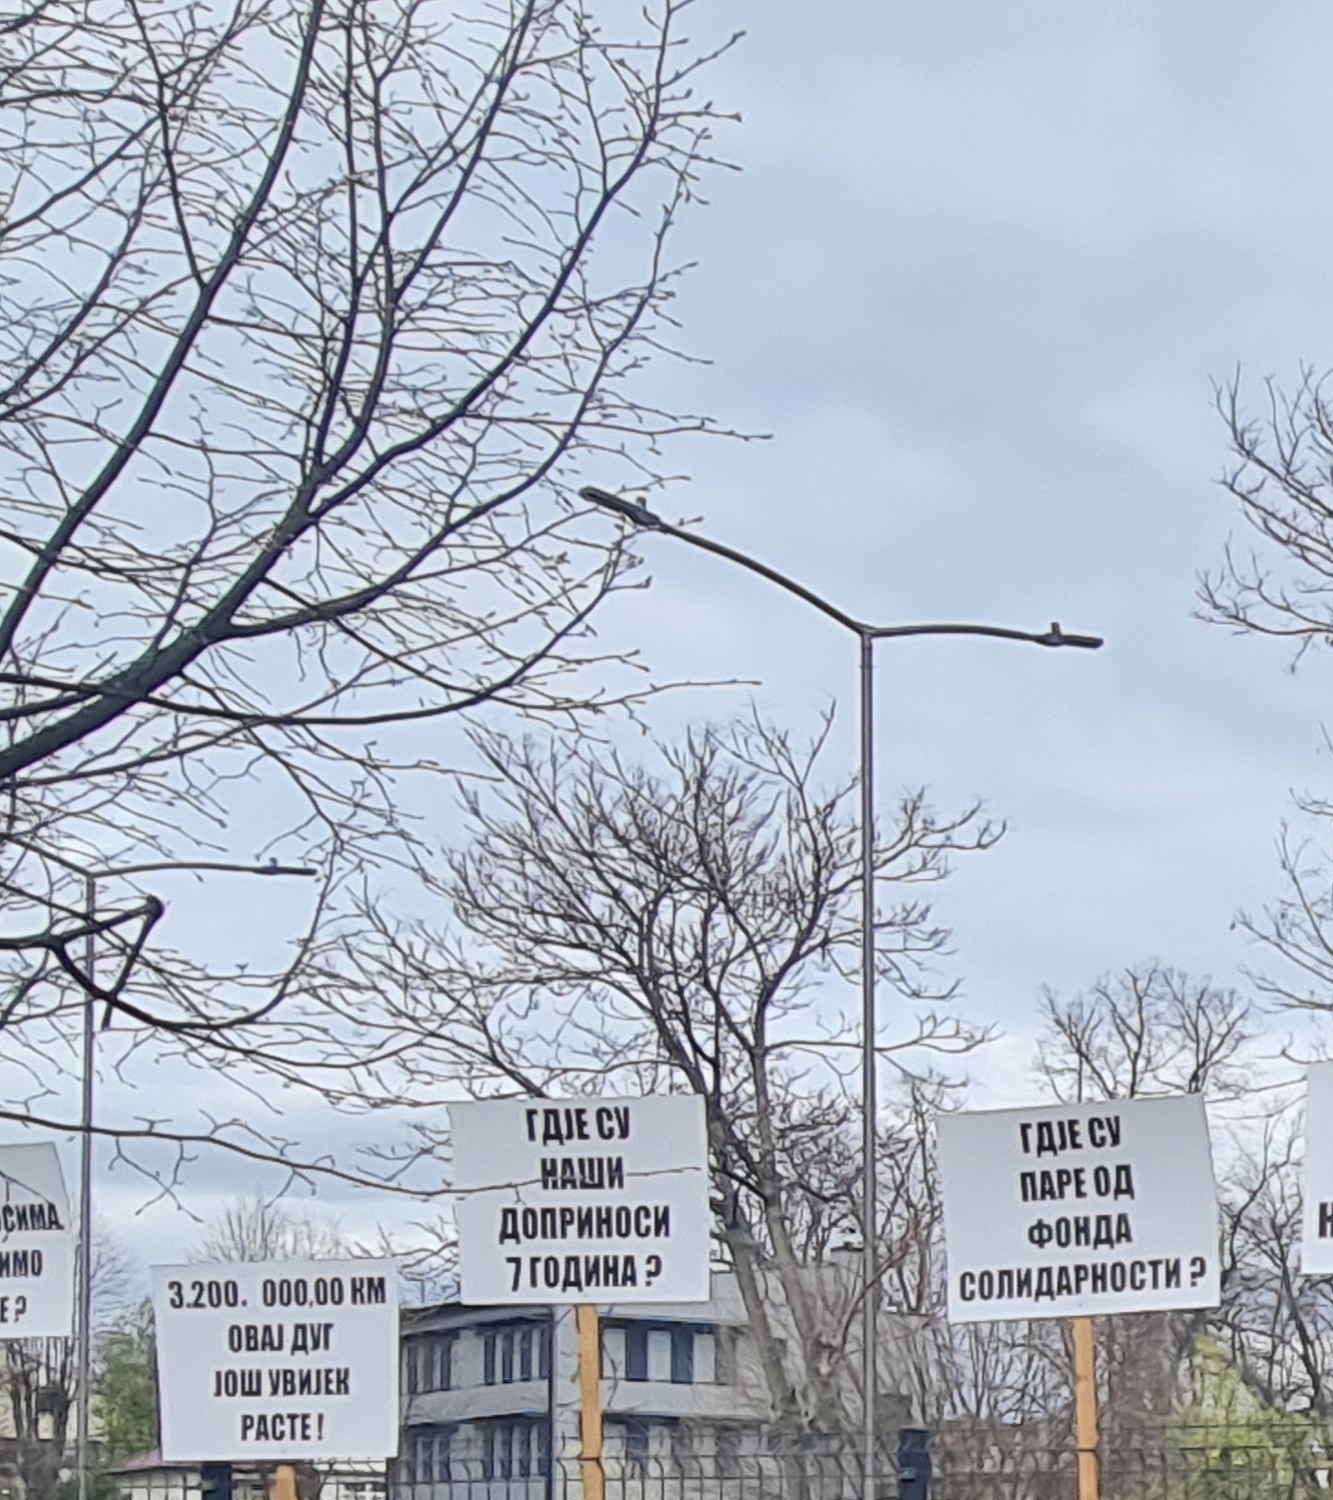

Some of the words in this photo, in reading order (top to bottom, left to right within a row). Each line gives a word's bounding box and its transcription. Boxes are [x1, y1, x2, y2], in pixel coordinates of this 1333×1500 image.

[526, 1108, 590, 1147] ГДЈЕ
[595, 1106, 630, 1141] СУ
[1019, 1119, 1083, 1158] ГДЈЕ
[1087, 1115, 1121, 1149] СУ
[541, 1156, 624, 1190] НАШИ
[1020, 1167, 1087, 1202] ПАРЕ
[1093, 1164, 1135, 1201] ОД
[499, 1205, 670, 1245] ДОПРИНОСИ
[1028, 1213, 1132, 1250] ФОНДА
[350, 1276, 386, 1305] КМ
[505, 1256, 522, 1292] 7
[529, 1255, 637, 1293] ГОДИНА
[960, 1258, 1180, 1302] СОЛИДАРНОСТИ
[228, 1323, 284, 1353] ОВАЈ
[290, 1323, 334, 1356] ДУГ
[214, 1369, 262, 1397] ЈОШ
[268, 1368, 350, 1396] УВИЈЕК
[241, 1413, 311, 1441] РАСТЕ
